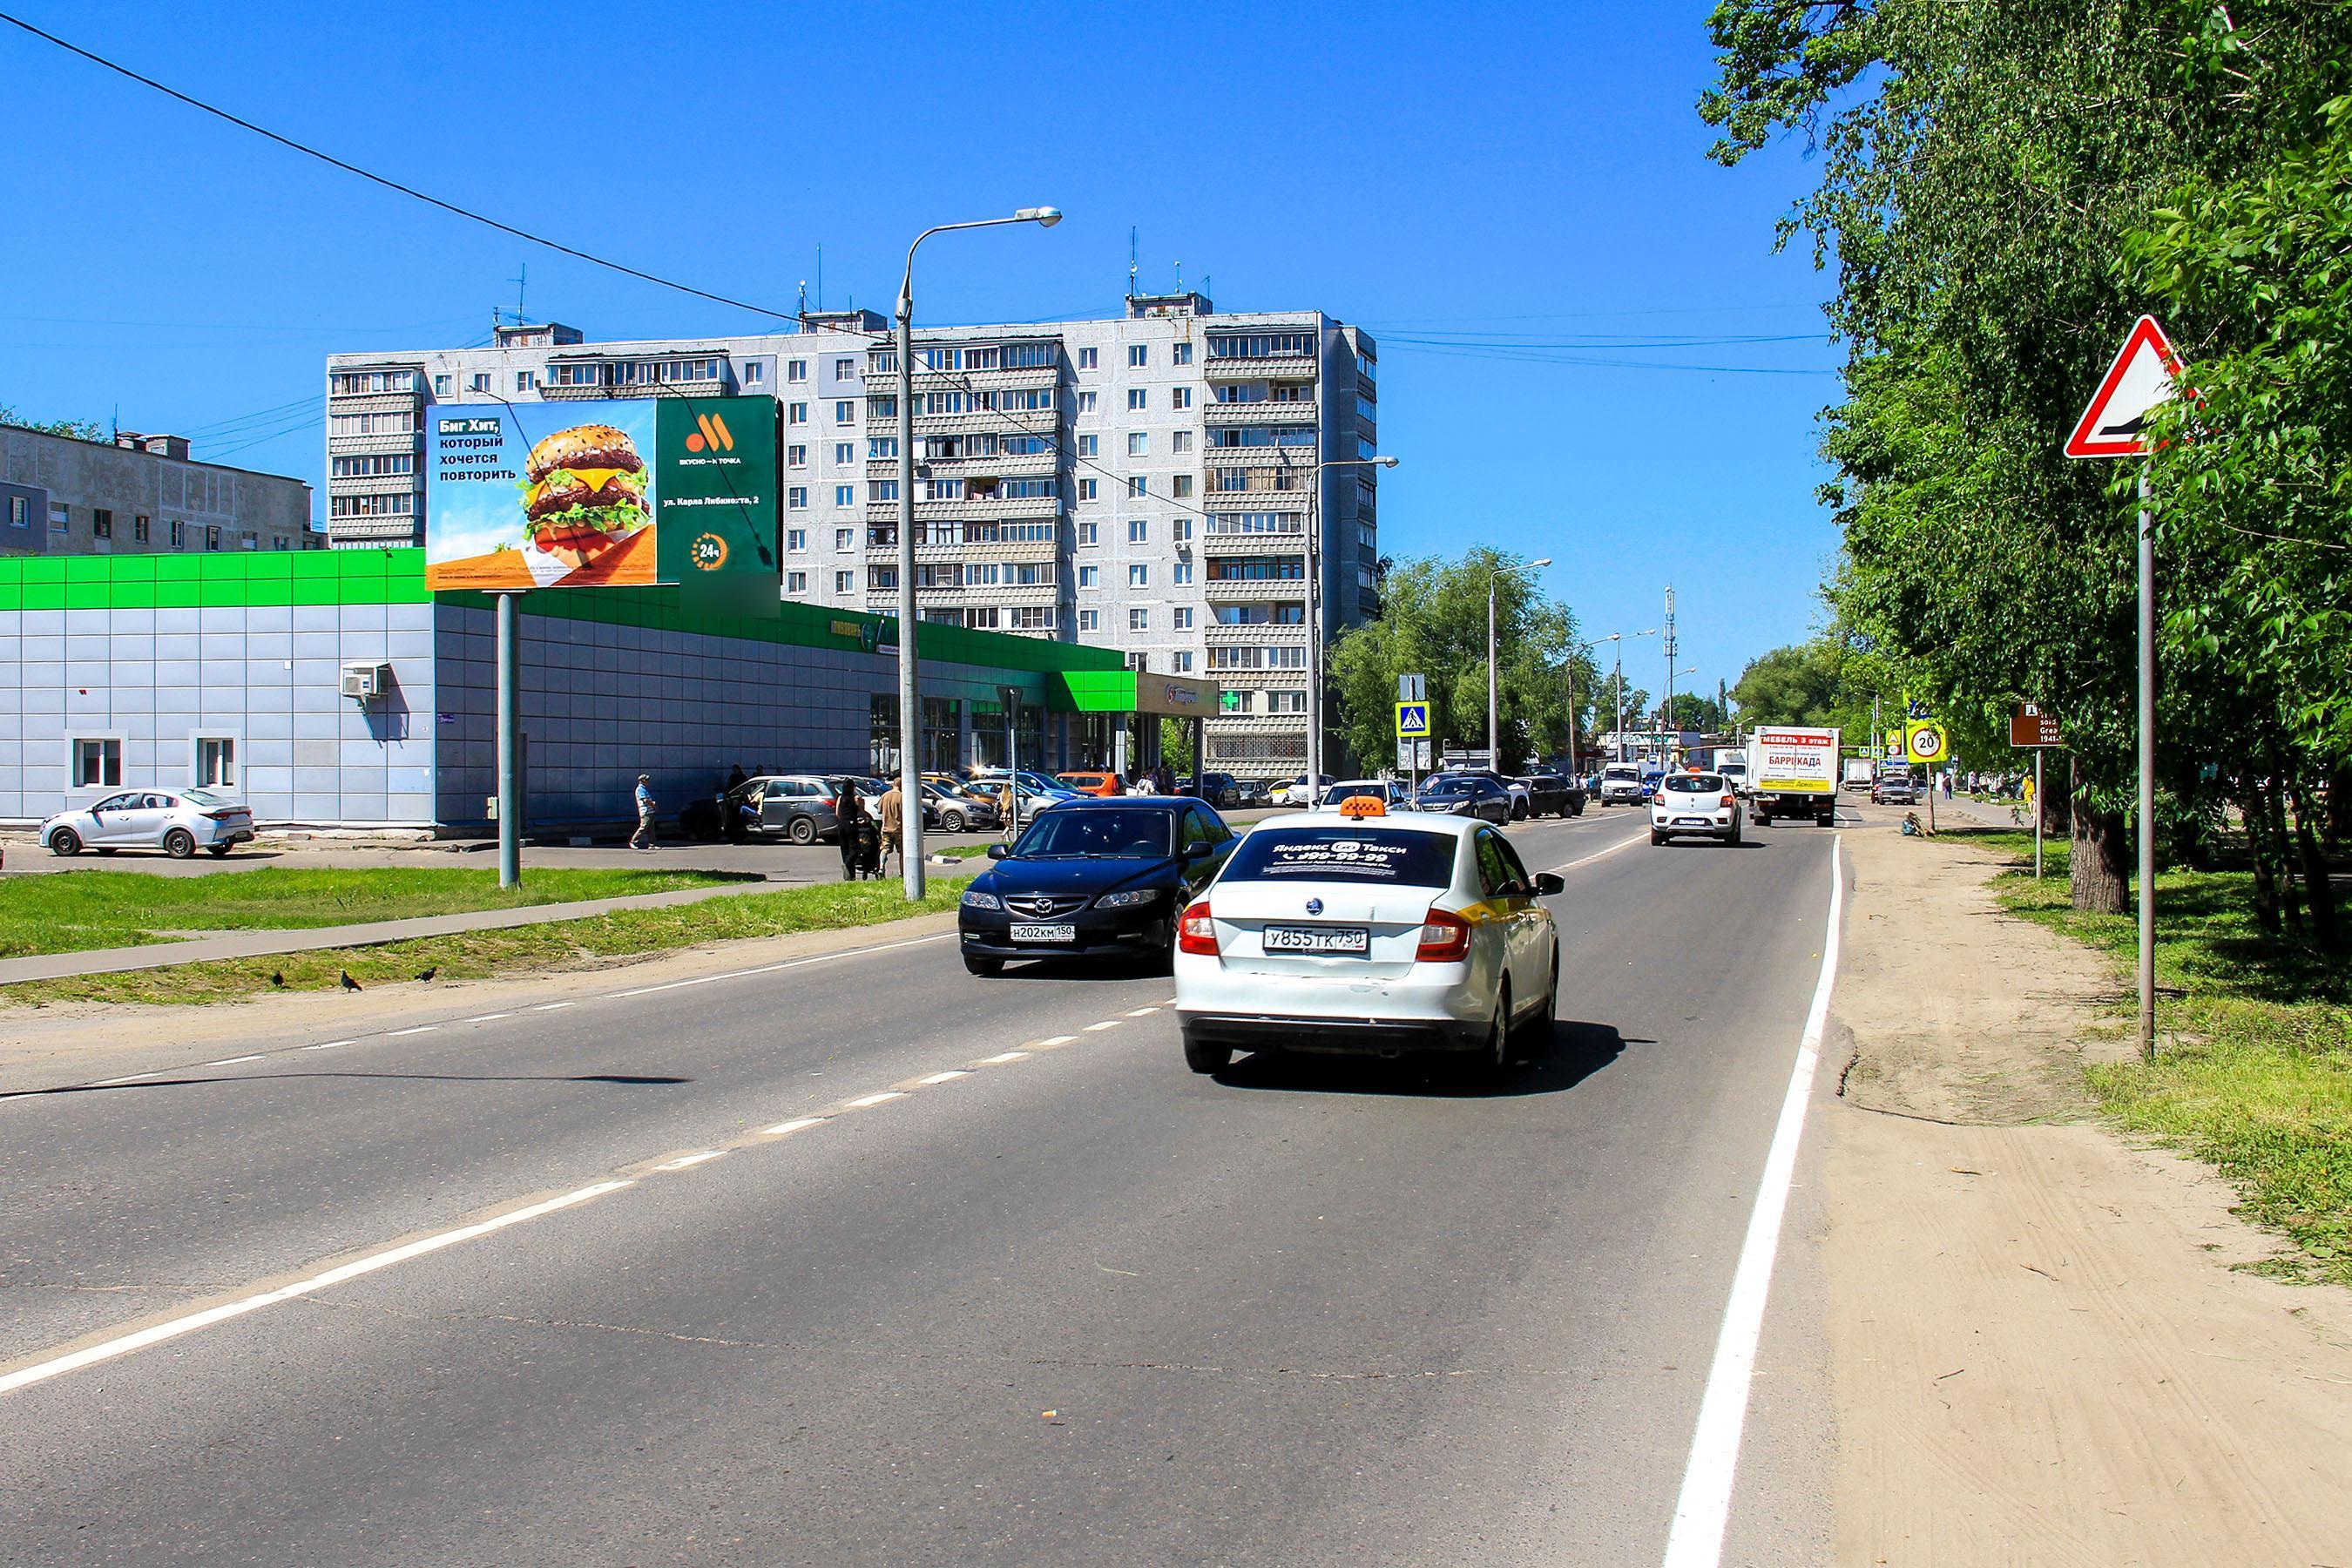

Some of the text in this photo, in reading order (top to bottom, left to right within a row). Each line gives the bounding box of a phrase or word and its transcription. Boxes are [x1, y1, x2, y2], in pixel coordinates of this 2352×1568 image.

[440, 419, 500, 434] Биг Хит,
[440, 434, 503, 449] который
[440, 454, 497, 465] хочется
[440, 470, 517, 482] повторить
[677, 497, 703, 506] Карла
[700, 544, 720, 558] 24ч
[1919, 738, 1934, 748] 20
[1273, 844, 1330, 853] Яндекс
[1362, 843, 1407, 855] Такси
[1013, 926, 1071, 938] Н202КМ 150
[1271, 929, 1363, 948] У855ТК 750
